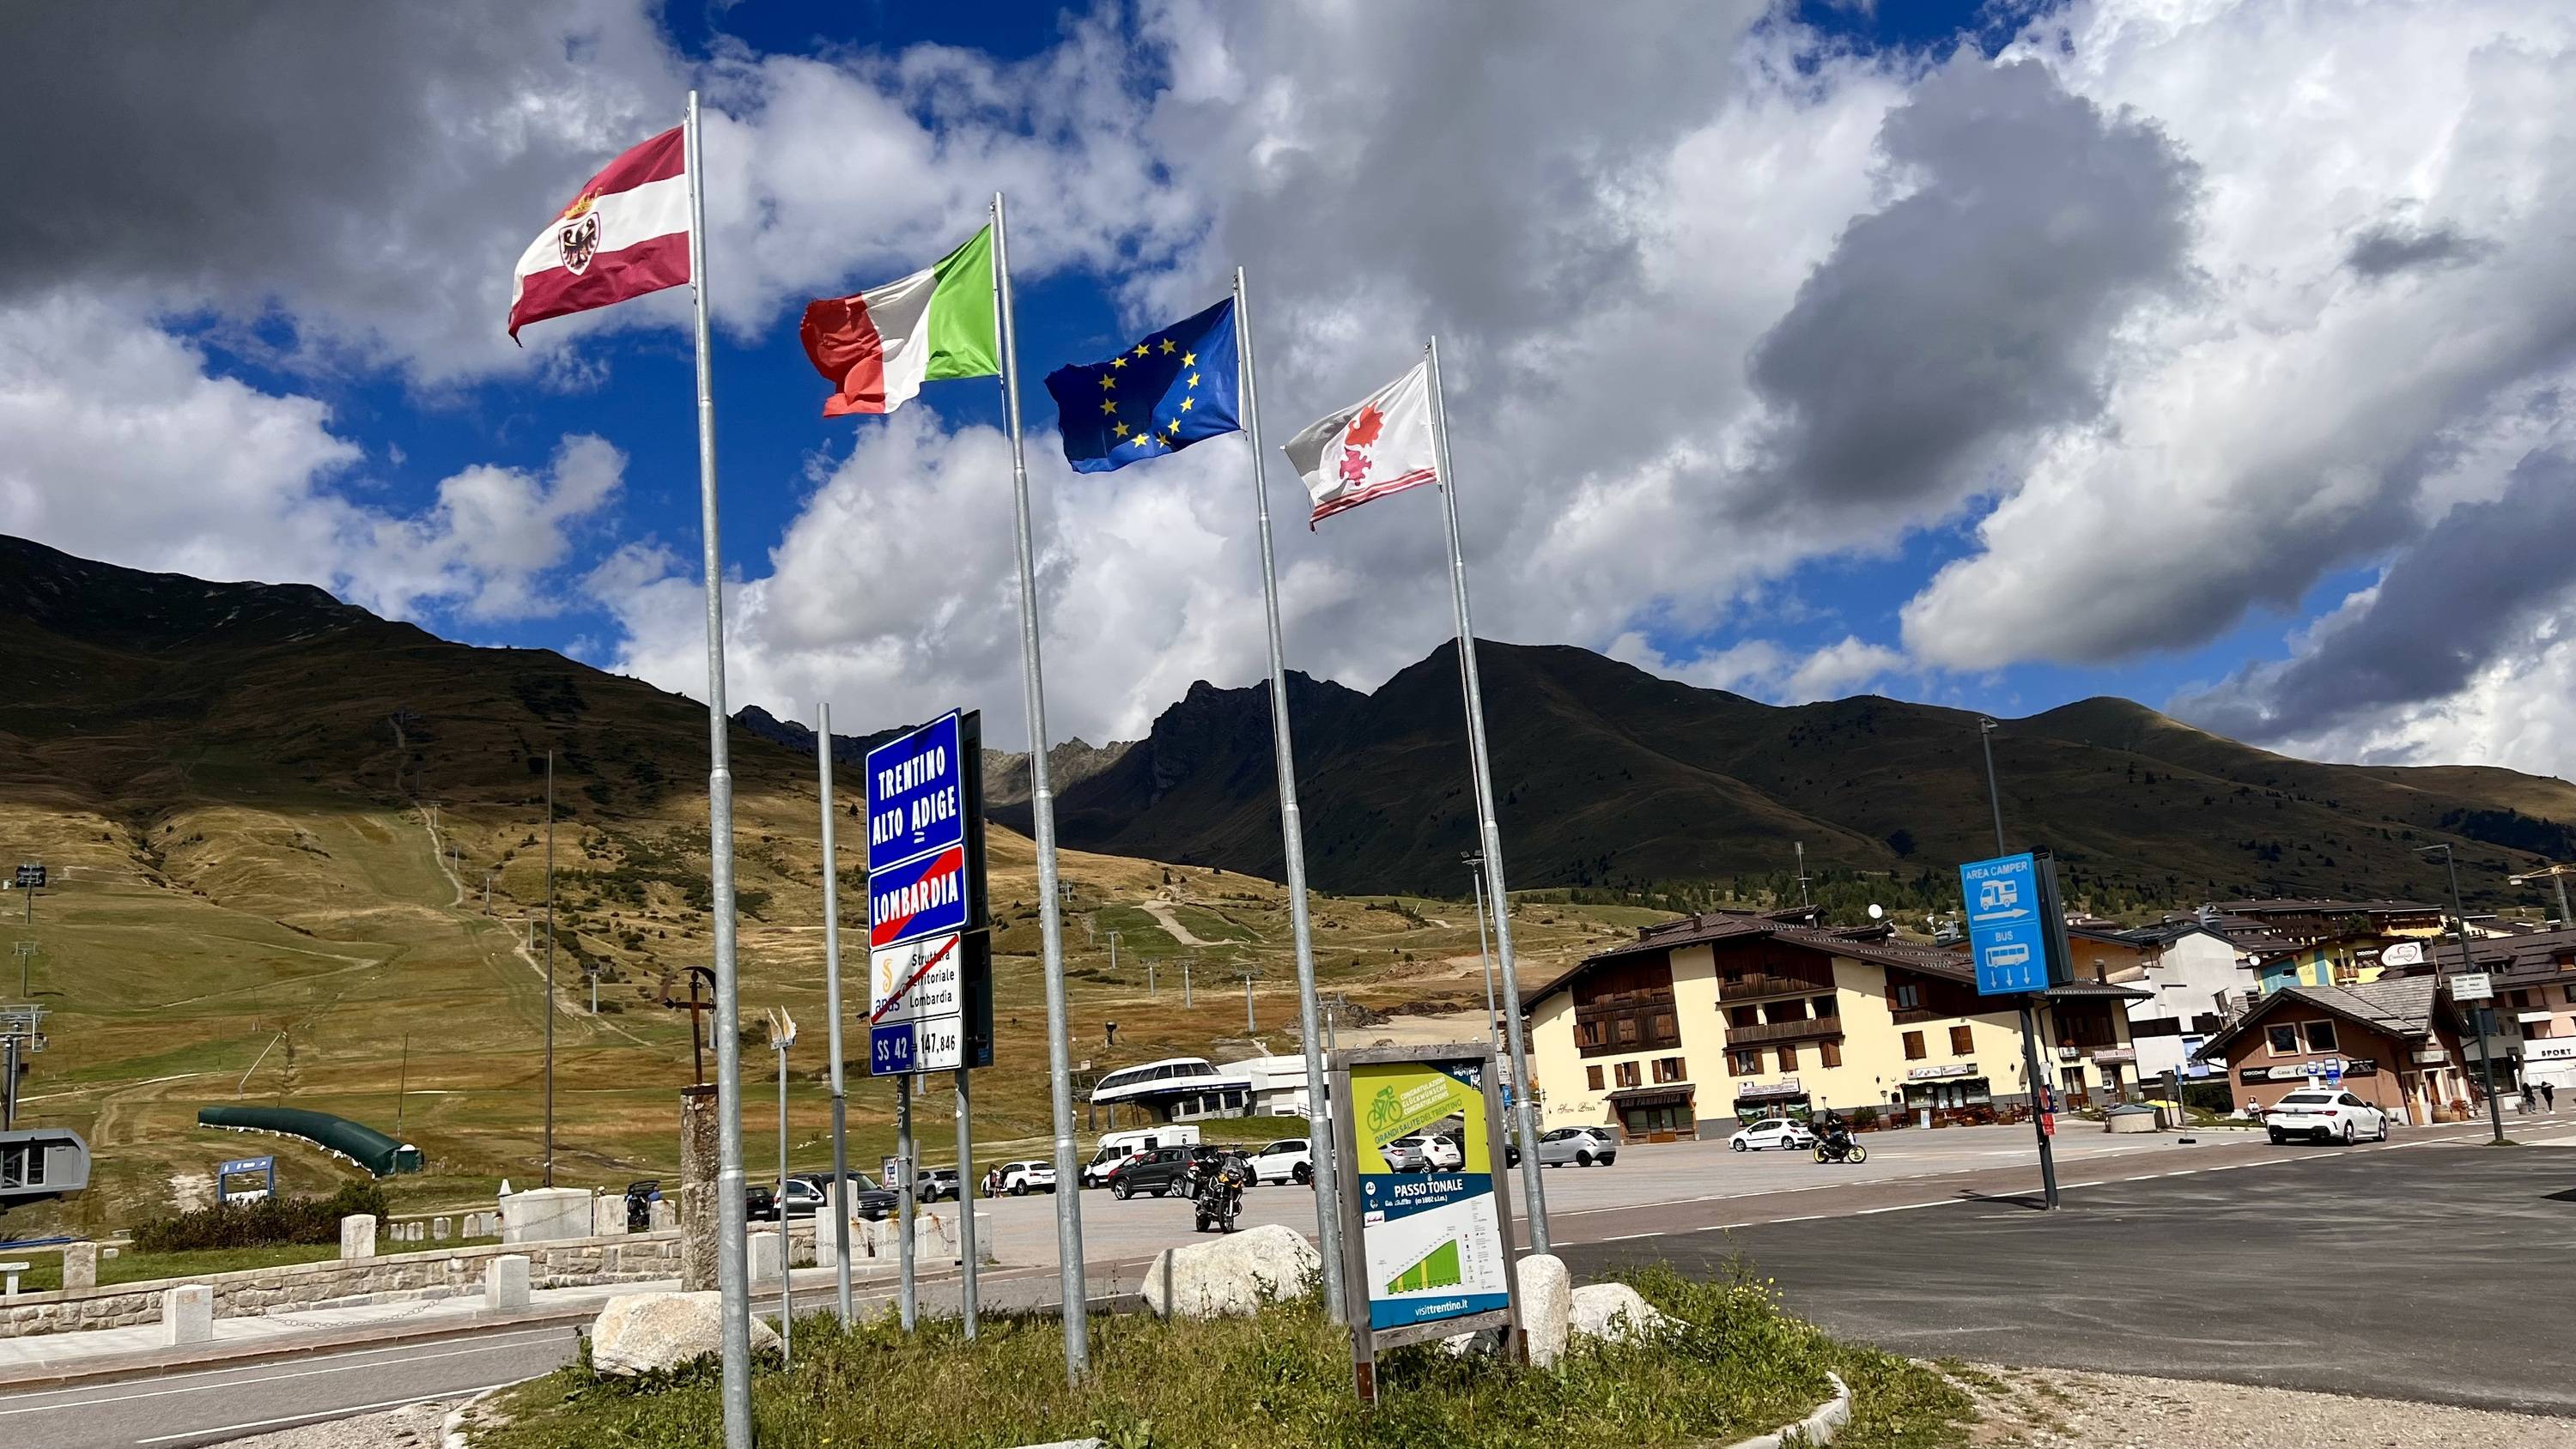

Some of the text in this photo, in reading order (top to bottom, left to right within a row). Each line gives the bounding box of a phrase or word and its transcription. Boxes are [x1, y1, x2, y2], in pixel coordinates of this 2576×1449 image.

[878, 745, 945, 801] TRENTINO
[872, 785, 957, 846] ALTO ADIGE
[1965, 861, 2028, 880] AREA CAMPER
[874, 870, 959, 926] LOMBARDIA
[1996, 931, 2014, 942] BUS
[912, 950, 950, 967] Struta
[908, 968, 955, 987] rritoriale
[876, 997, 900, 1012] anas
[910, 990, 952, 1008] Lombardia
[878, 1036, 908, 1061] SS 42
[920, 1033, 956, 1055] 147,846
[2541, 1048, 2572, 1058] SPORT
[1400, 1076, 1446, 1100] CONGRATULAZIONI
[1403, 1089, 1449, 1115] CONGRATULATIONS
[1375, 1126, 1400, 1144] GRANDI
[1399, 1117, 1421, 1133] SALITE
[1431, 1099, 1462, 1118] TRENTINO
[1394, 1179, 1463, 1197] PASSO TONALE
[1415, 1299, 1468, 1316] visittrentino.it
